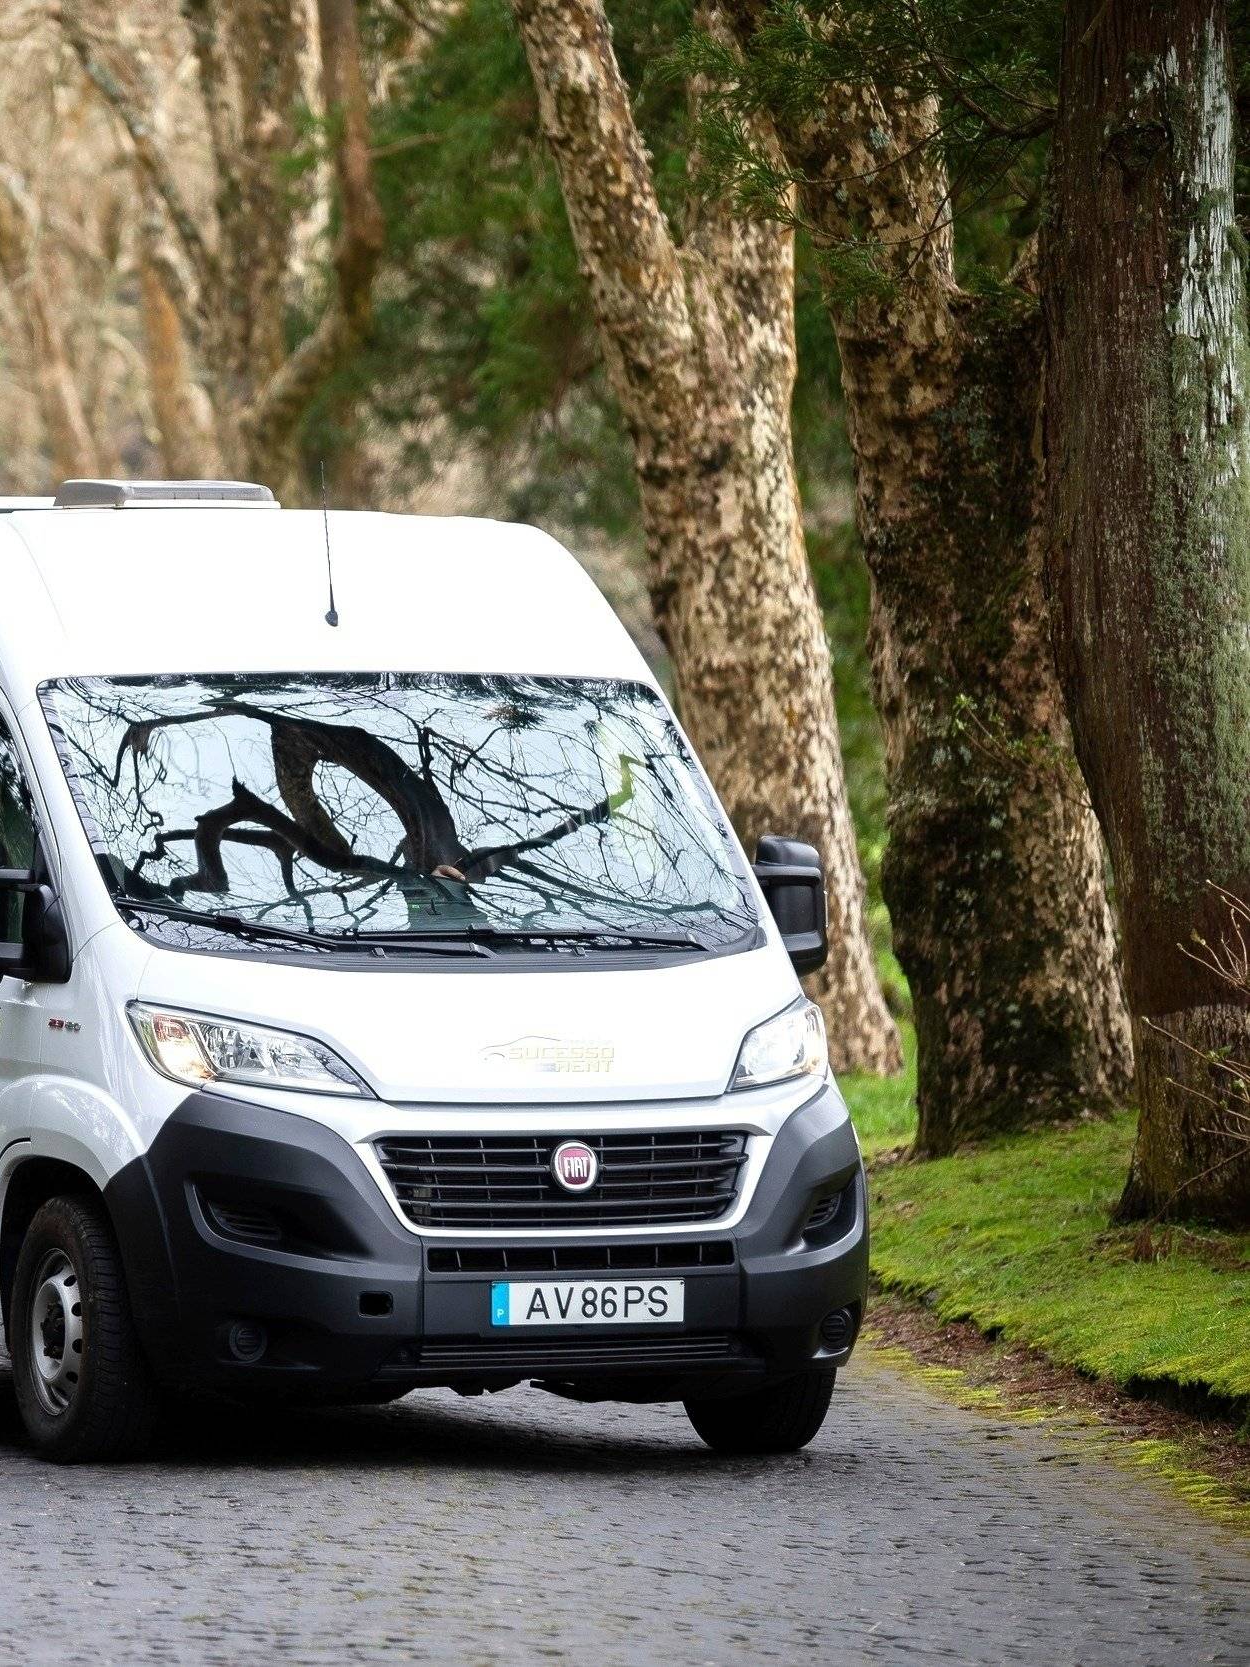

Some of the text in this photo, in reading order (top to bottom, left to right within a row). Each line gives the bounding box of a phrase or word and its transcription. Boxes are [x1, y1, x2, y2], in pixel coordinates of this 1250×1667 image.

[508, 1047, 615, 1060] SUCESSO
[555, 1059, 614, 1073] RENT
[563, 1156, 589, 1178] FIAT
